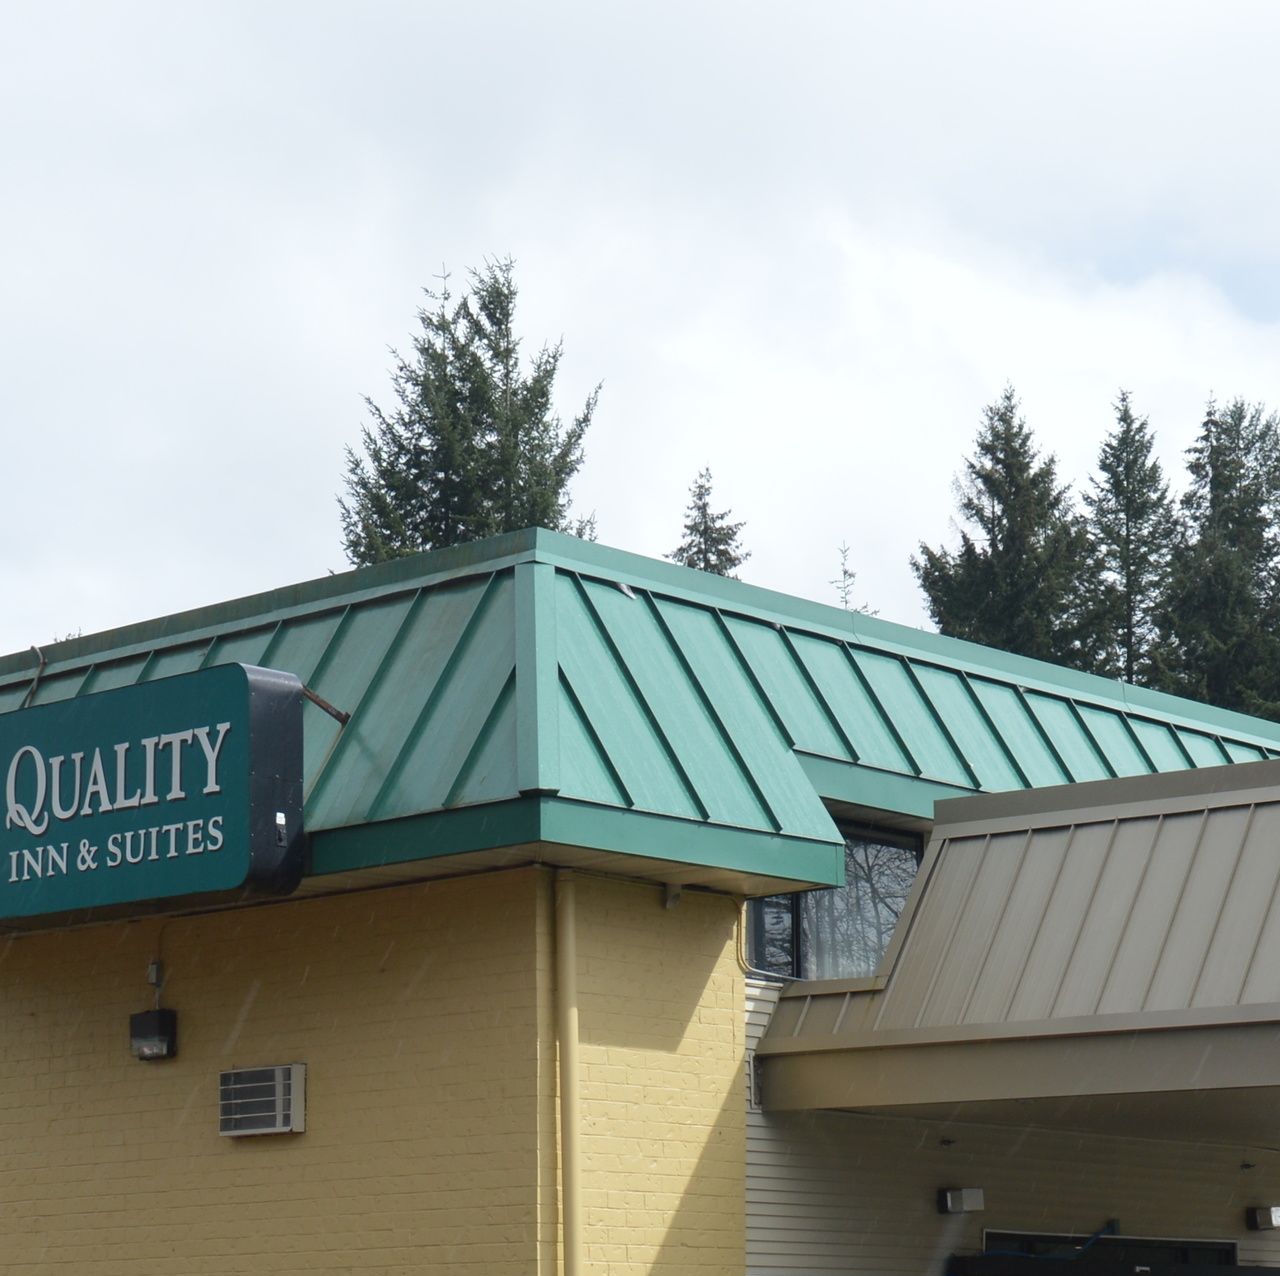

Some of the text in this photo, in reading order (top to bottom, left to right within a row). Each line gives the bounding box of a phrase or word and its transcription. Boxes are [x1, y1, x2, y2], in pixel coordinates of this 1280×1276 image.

[6, 722, 231, 835] QUALITY
[8, 816, 224, 882] INN & SUITES
